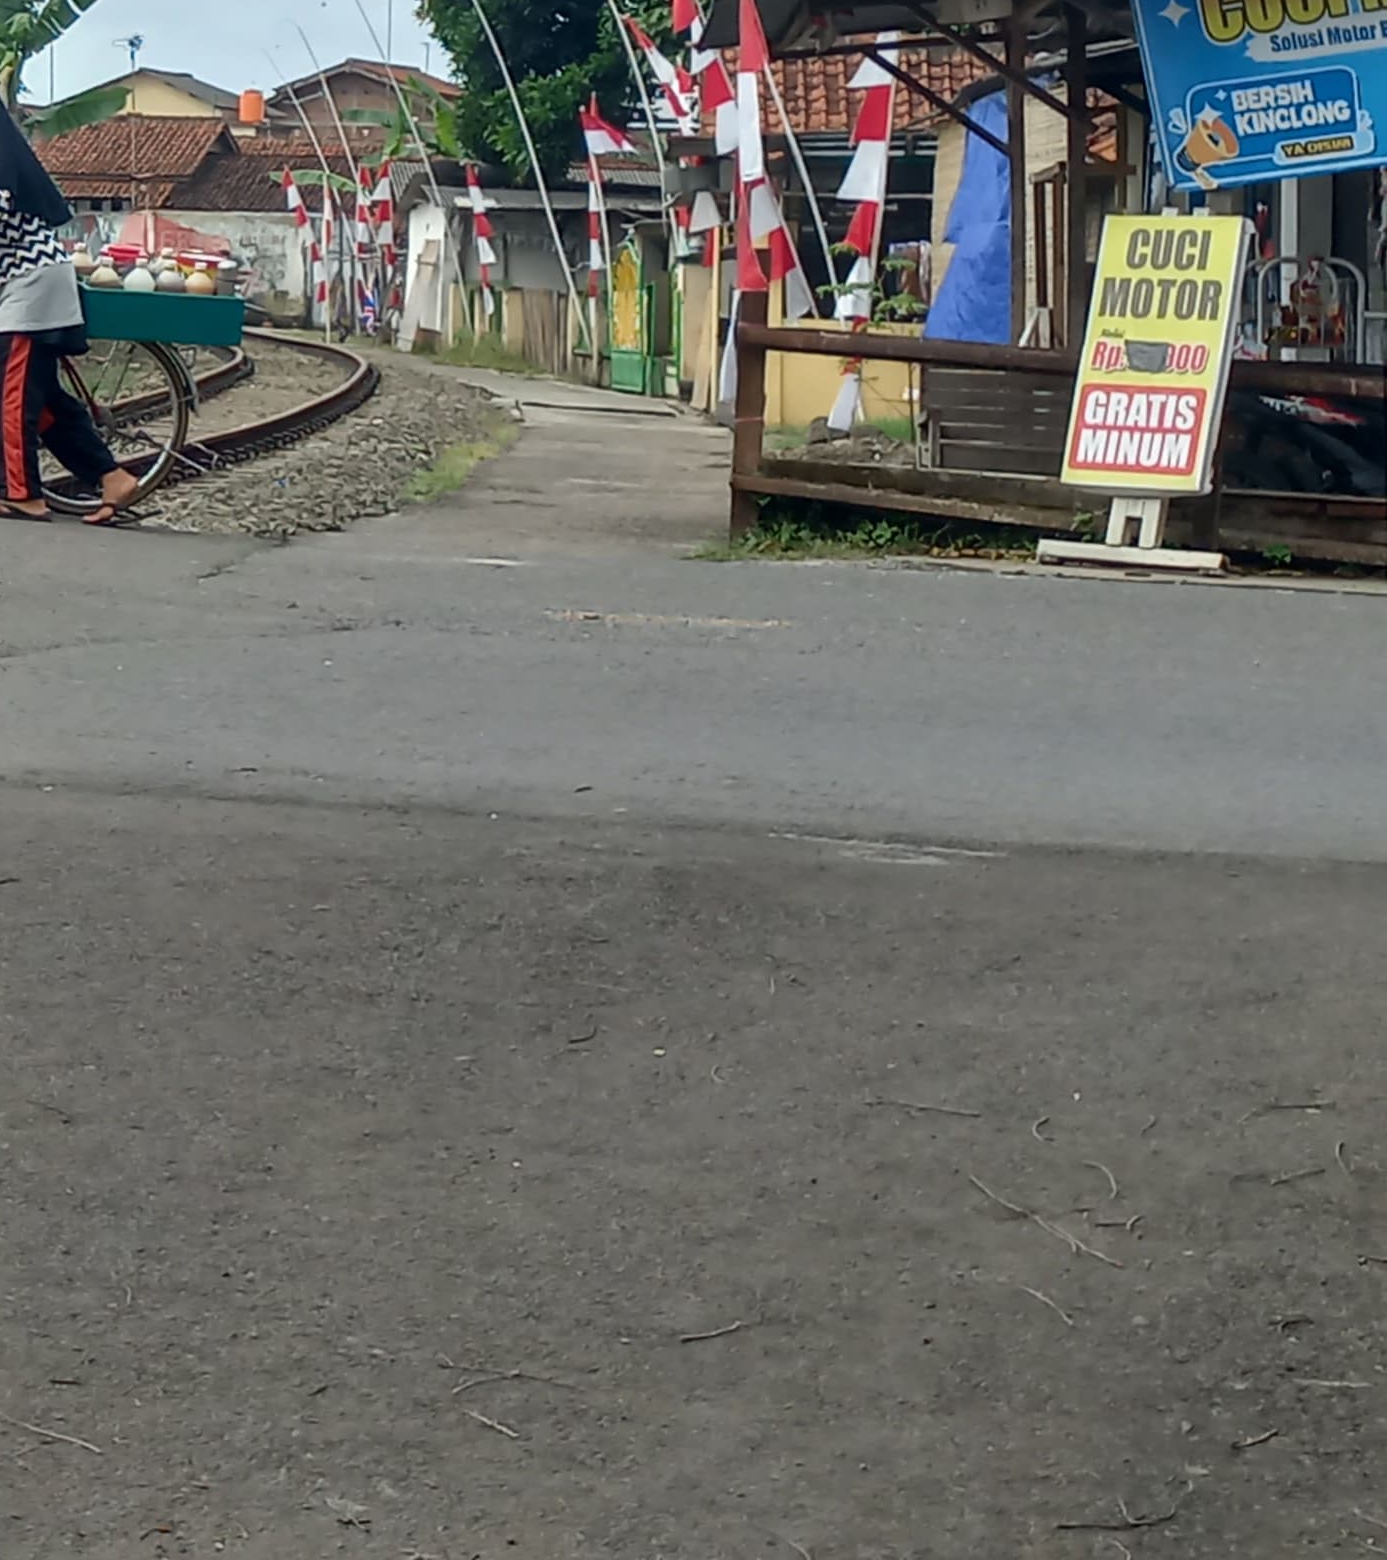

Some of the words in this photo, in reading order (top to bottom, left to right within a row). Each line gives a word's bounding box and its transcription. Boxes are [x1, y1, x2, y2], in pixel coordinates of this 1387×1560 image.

[1269, 28, 1325, 53] Solusi
[1326, 24, 1377, 46] Motor
[1231, 80, 1314, 112] BERSIH
[1234, 99, 1351, 137] KINCLONG
[1125, 228, 1212, 271] CUCI
[1098, 277, 1223, 321] MOTOR
[1083, 390, 1197, 431] GRATIS
[1075, 427, 1192, 470] MINUM
